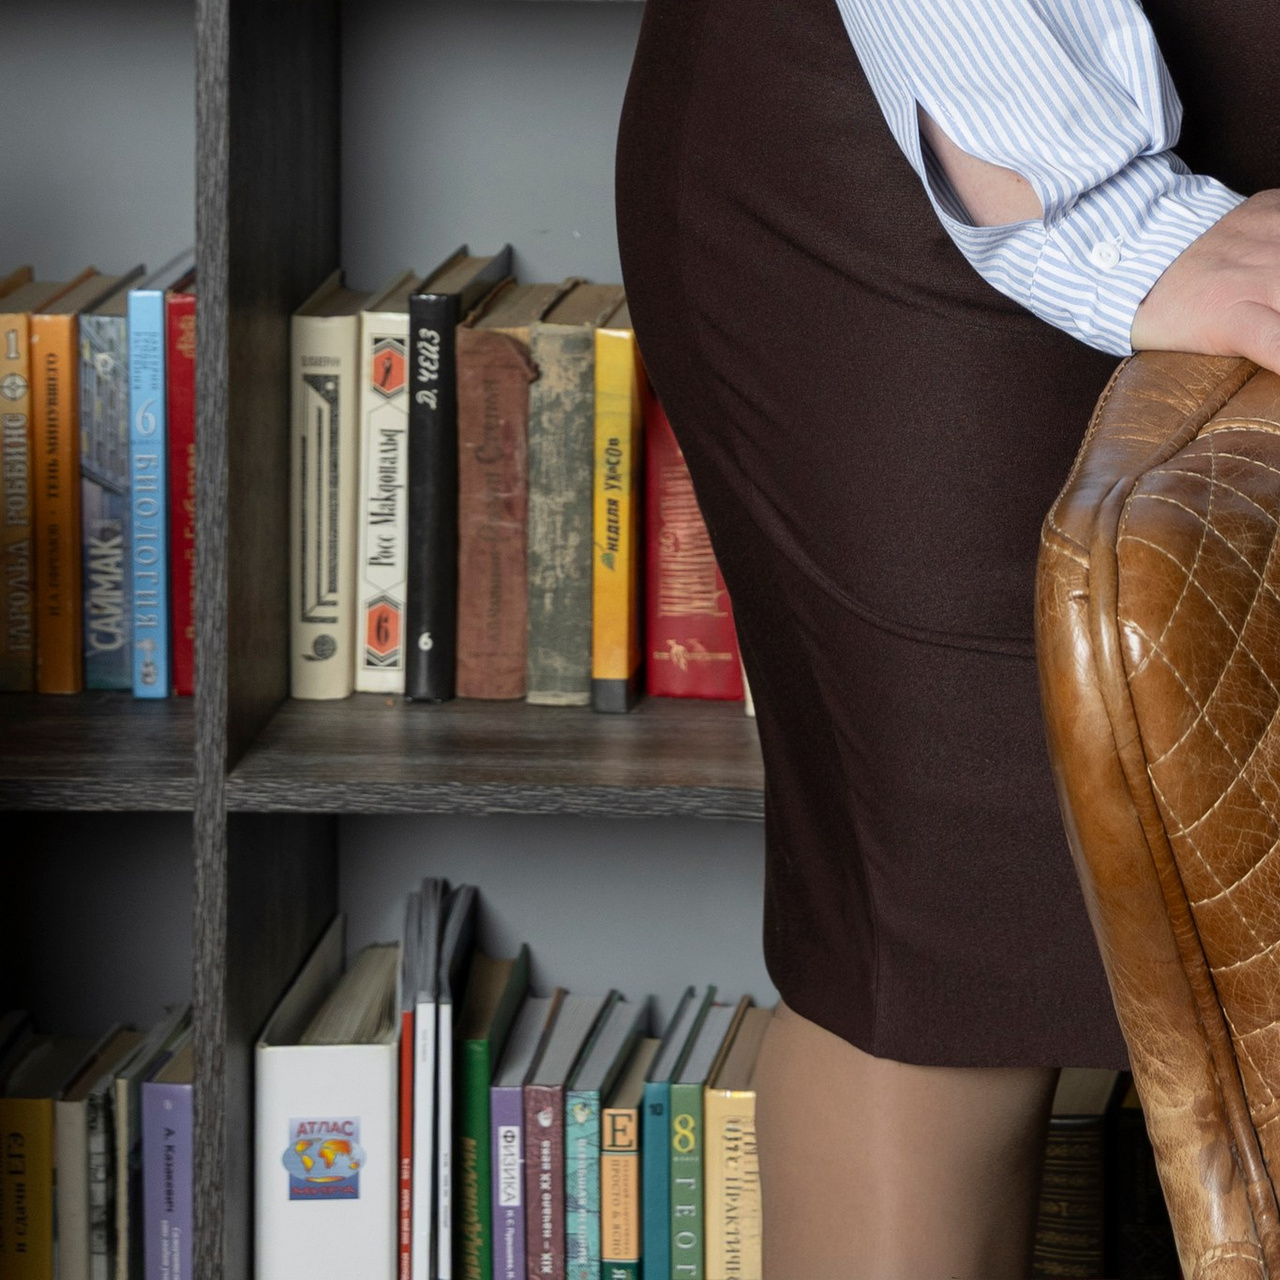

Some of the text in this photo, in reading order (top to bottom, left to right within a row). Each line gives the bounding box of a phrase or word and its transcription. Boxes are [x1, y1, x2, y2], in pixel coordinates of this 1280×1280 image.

[416, 328, 440, 382] ЧЕЙЗ
[45, 352, 60, 500] ТЕНЬ МИНУВШЕГО
[0, 413, 31, 652] ГАРОЛЬД РОББИНС
[134, 454, 159, 629] БИОЛОГИЯ
[368, 534, 396, 567] Росс
[604, 499, 620, 552] НЕДЕЛЯ
[88, 536, 123, 651] САЙМАК
[417, 632, 433, 651] 6
[8, 1132, 26, 1175] ЕГЭ
[296, 1120, 354, 1138] АТЛАС
[672, 1114, 695, 1154] 8
[292, 1185, 356, 1195] МИРА
[501, 1129, 519, 1203] ФИЗИКА
[539, 1140, 553, 1274] XIX начало XX века
